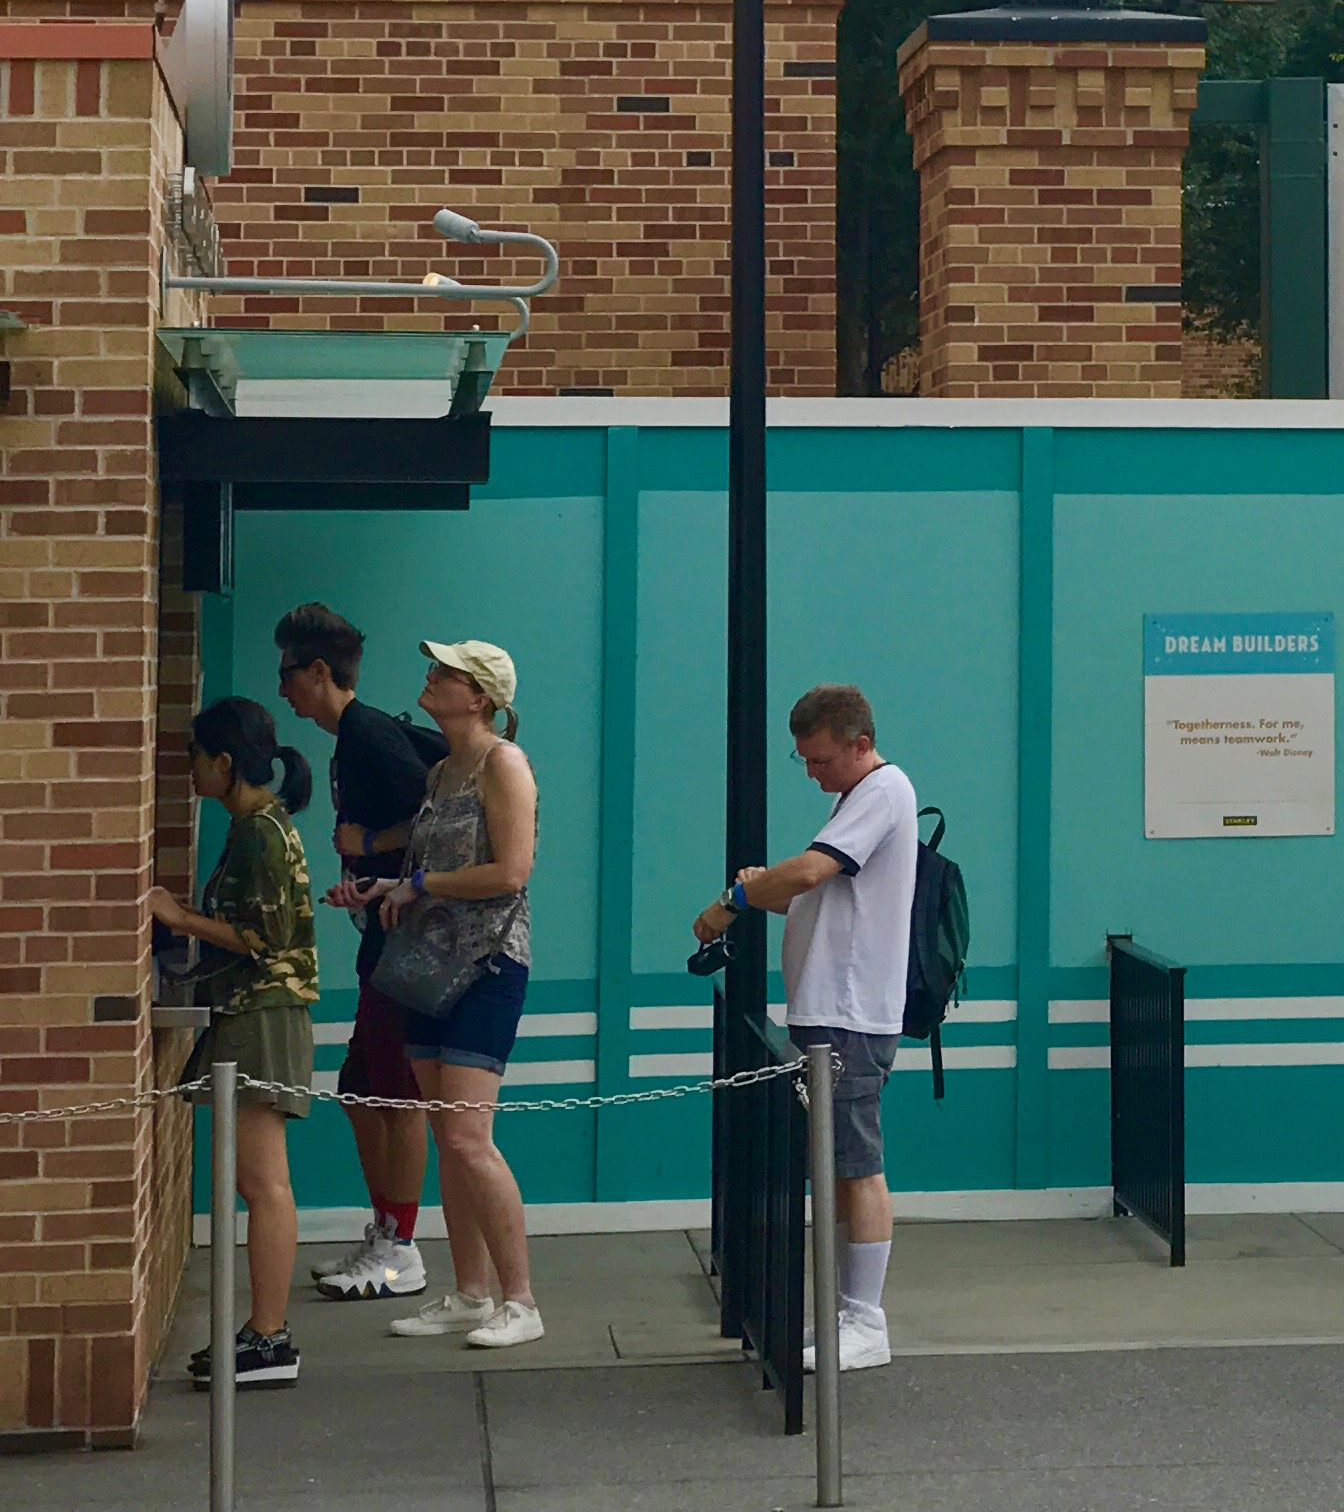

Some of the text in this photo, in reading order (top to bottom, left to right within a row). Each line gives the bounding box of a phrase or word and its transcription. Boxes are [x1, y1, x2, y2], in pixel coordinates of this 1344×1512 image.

[1165, 635, 1319, 654] DREAM BUILDERS
[1259, 719, 1279, 729] For
[1282, 720, 1304, 730] me,
[1180, 736, 1221, 745] means
[1283, 748, 1313, 758] Disney
